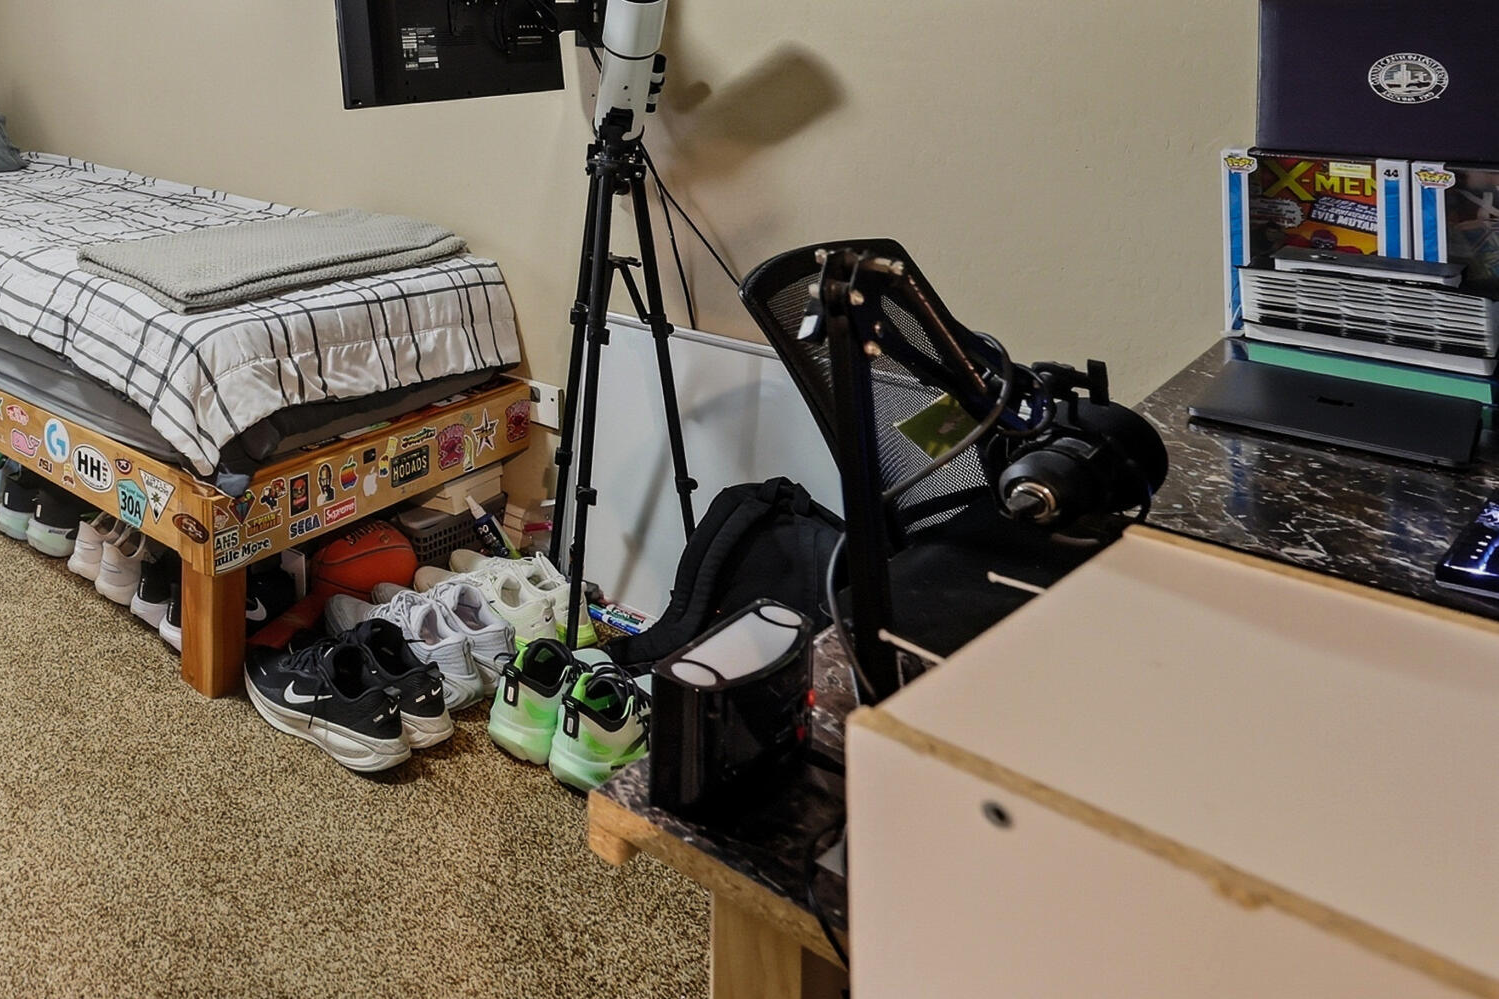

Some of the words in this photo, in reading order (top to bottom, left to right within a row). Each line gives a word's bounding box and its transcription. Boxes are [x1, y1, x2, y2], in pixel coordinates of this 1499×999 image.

[1384, 169, 1399, 178] 44
[1311, 210, 1335, 222] EVIL
[77, 450, 101, 482] HH
[392, 455, 427, 481] HODADS
[120, 490, 142, 521] 30A
[326, 500, 356, 521] Supreme
[290, 513, 321, 539] SEGA
[214, 549, 240, 566] mile
[240, 537, 271, 558] More
[215, 531, 239, 550] ANS
